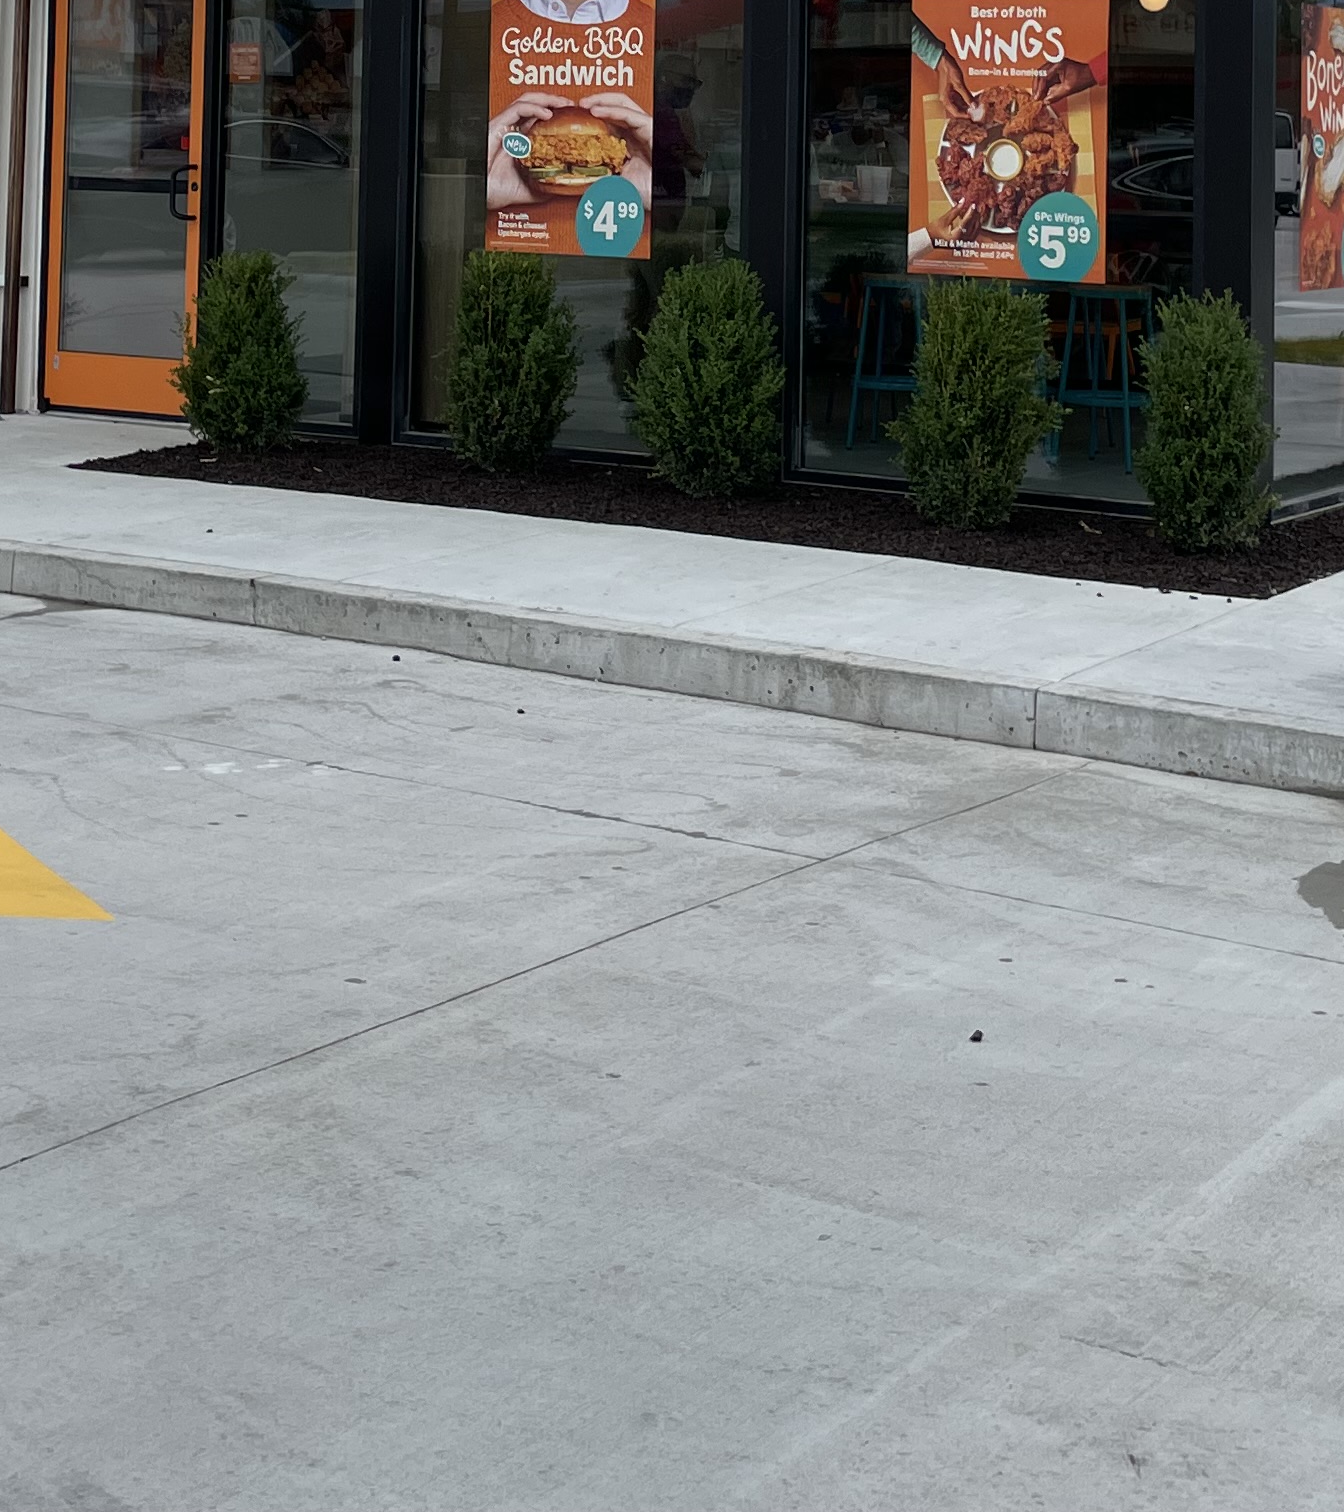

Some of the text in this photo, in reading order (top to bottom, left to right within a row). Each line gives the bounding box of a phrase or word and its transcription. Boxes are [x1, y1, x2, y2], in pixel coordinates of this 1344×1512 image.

[970, 5, 1047, 18] Best of both
[502, 27, 644, 59] Golden BBQ
[508, 58, 634, 87] Sandwich
[968, 67, 1048, 77] Bone-in & Boneless
[498, 220, 518, 228] Bacon
[1034, 211, 1085, 225] 6Pc Wings
[934, 238, 1015, 251] Mix & Match available
[962, 249, 979, 258] 12Pc
[980, 250, 994, 259] and
[995, 251, 1014, 260] 24Pc
